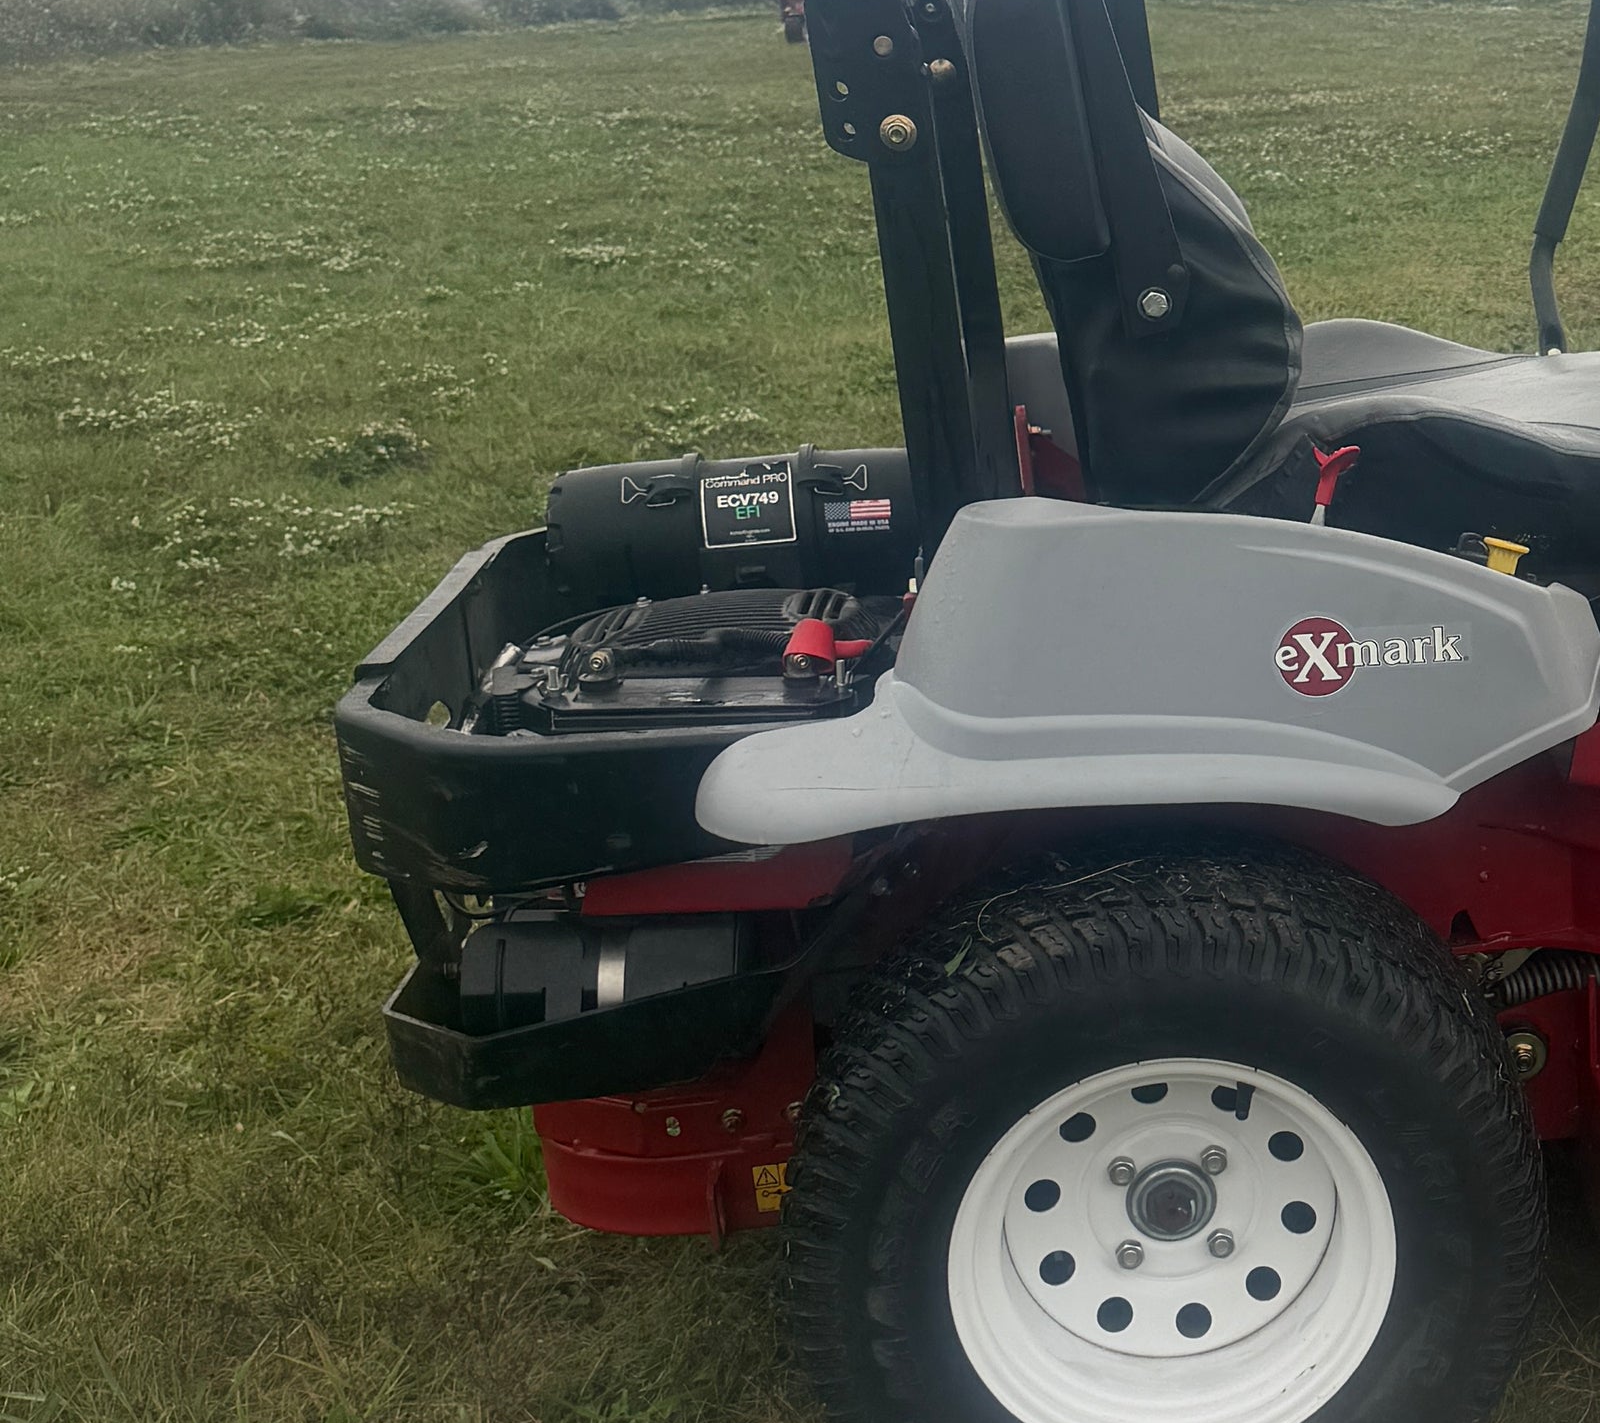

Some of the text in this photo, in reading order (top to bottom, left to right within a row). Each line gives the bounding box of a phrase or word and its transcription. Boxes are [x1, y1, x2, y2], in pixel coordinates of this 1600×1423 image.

[705, 475, 760, 489] Command
[762, 472, 788, 484] PRO
[716, 491, 779, 508] ECV749
[735, 506, 760, 520] EFI
